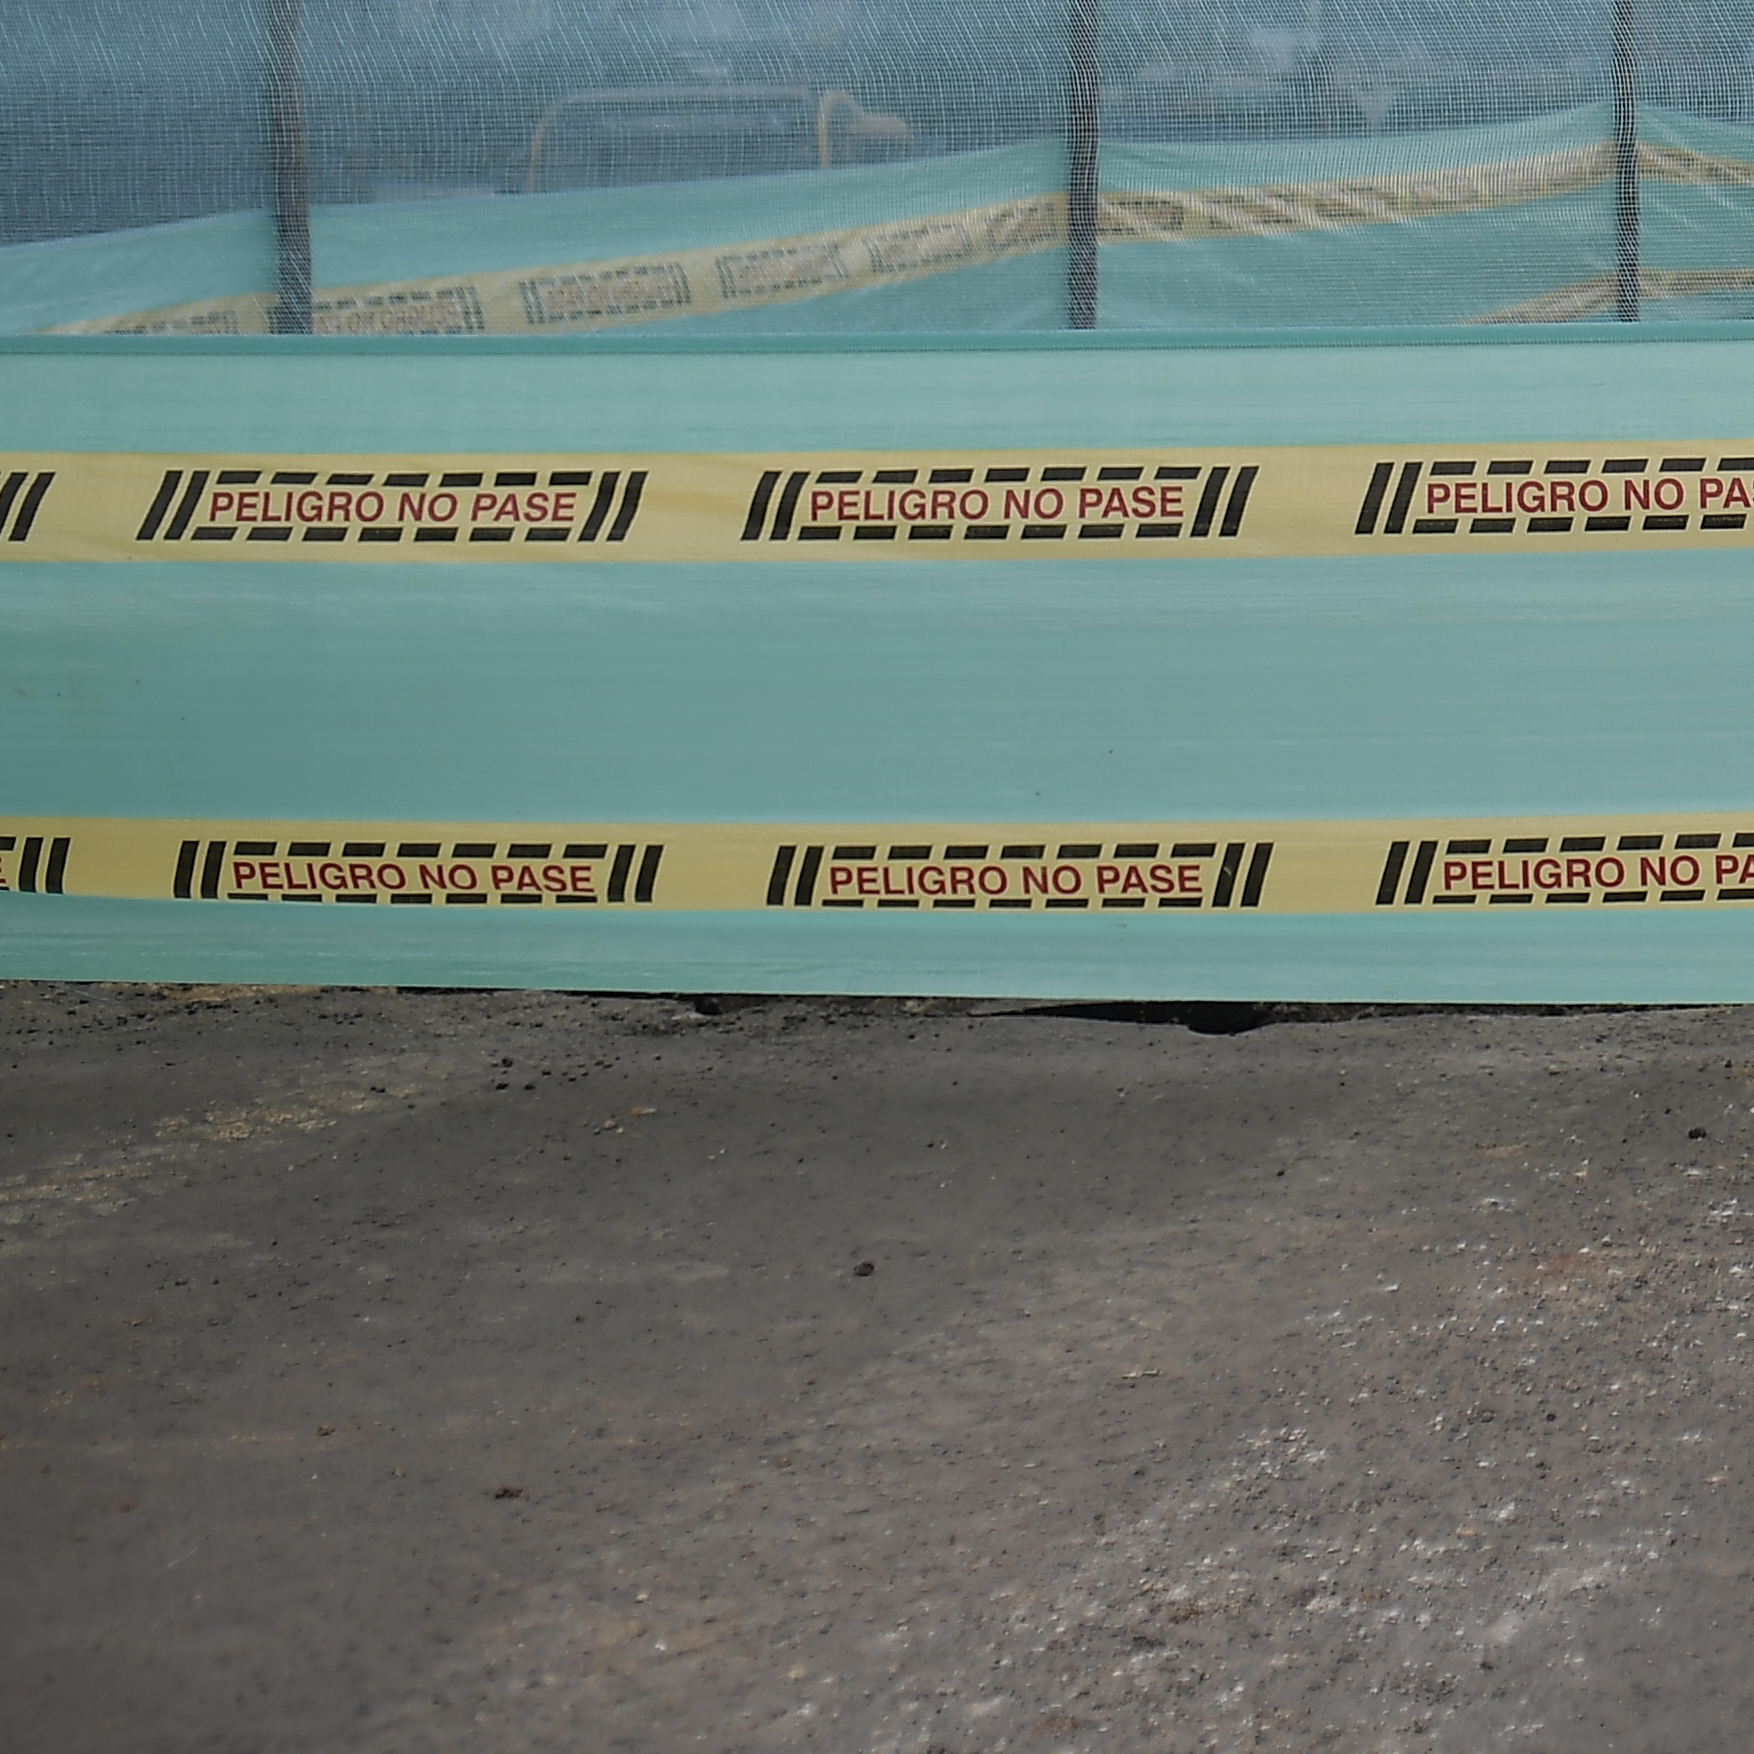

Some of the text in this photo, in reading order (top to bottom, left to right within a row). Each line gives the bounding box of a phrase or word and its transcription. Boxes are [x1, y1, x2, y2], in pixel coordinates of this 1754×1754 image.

[211, 491, 576, 522] PELIGRO NO PASE
[812, 486, 1184, 521] PELIGRO NO PASE
[1427, 480, 1609, 514] PELIGRO
[1625, 478, 1685, 511] NO
[233, 861, 594, 893] PELIGRO NO PASE
[830, 863, 1202, 896] PELIGRO NO PASE
[1443, 856, 1625, 890] PELIGRO
[1640, 854, 1700, 887] NO
